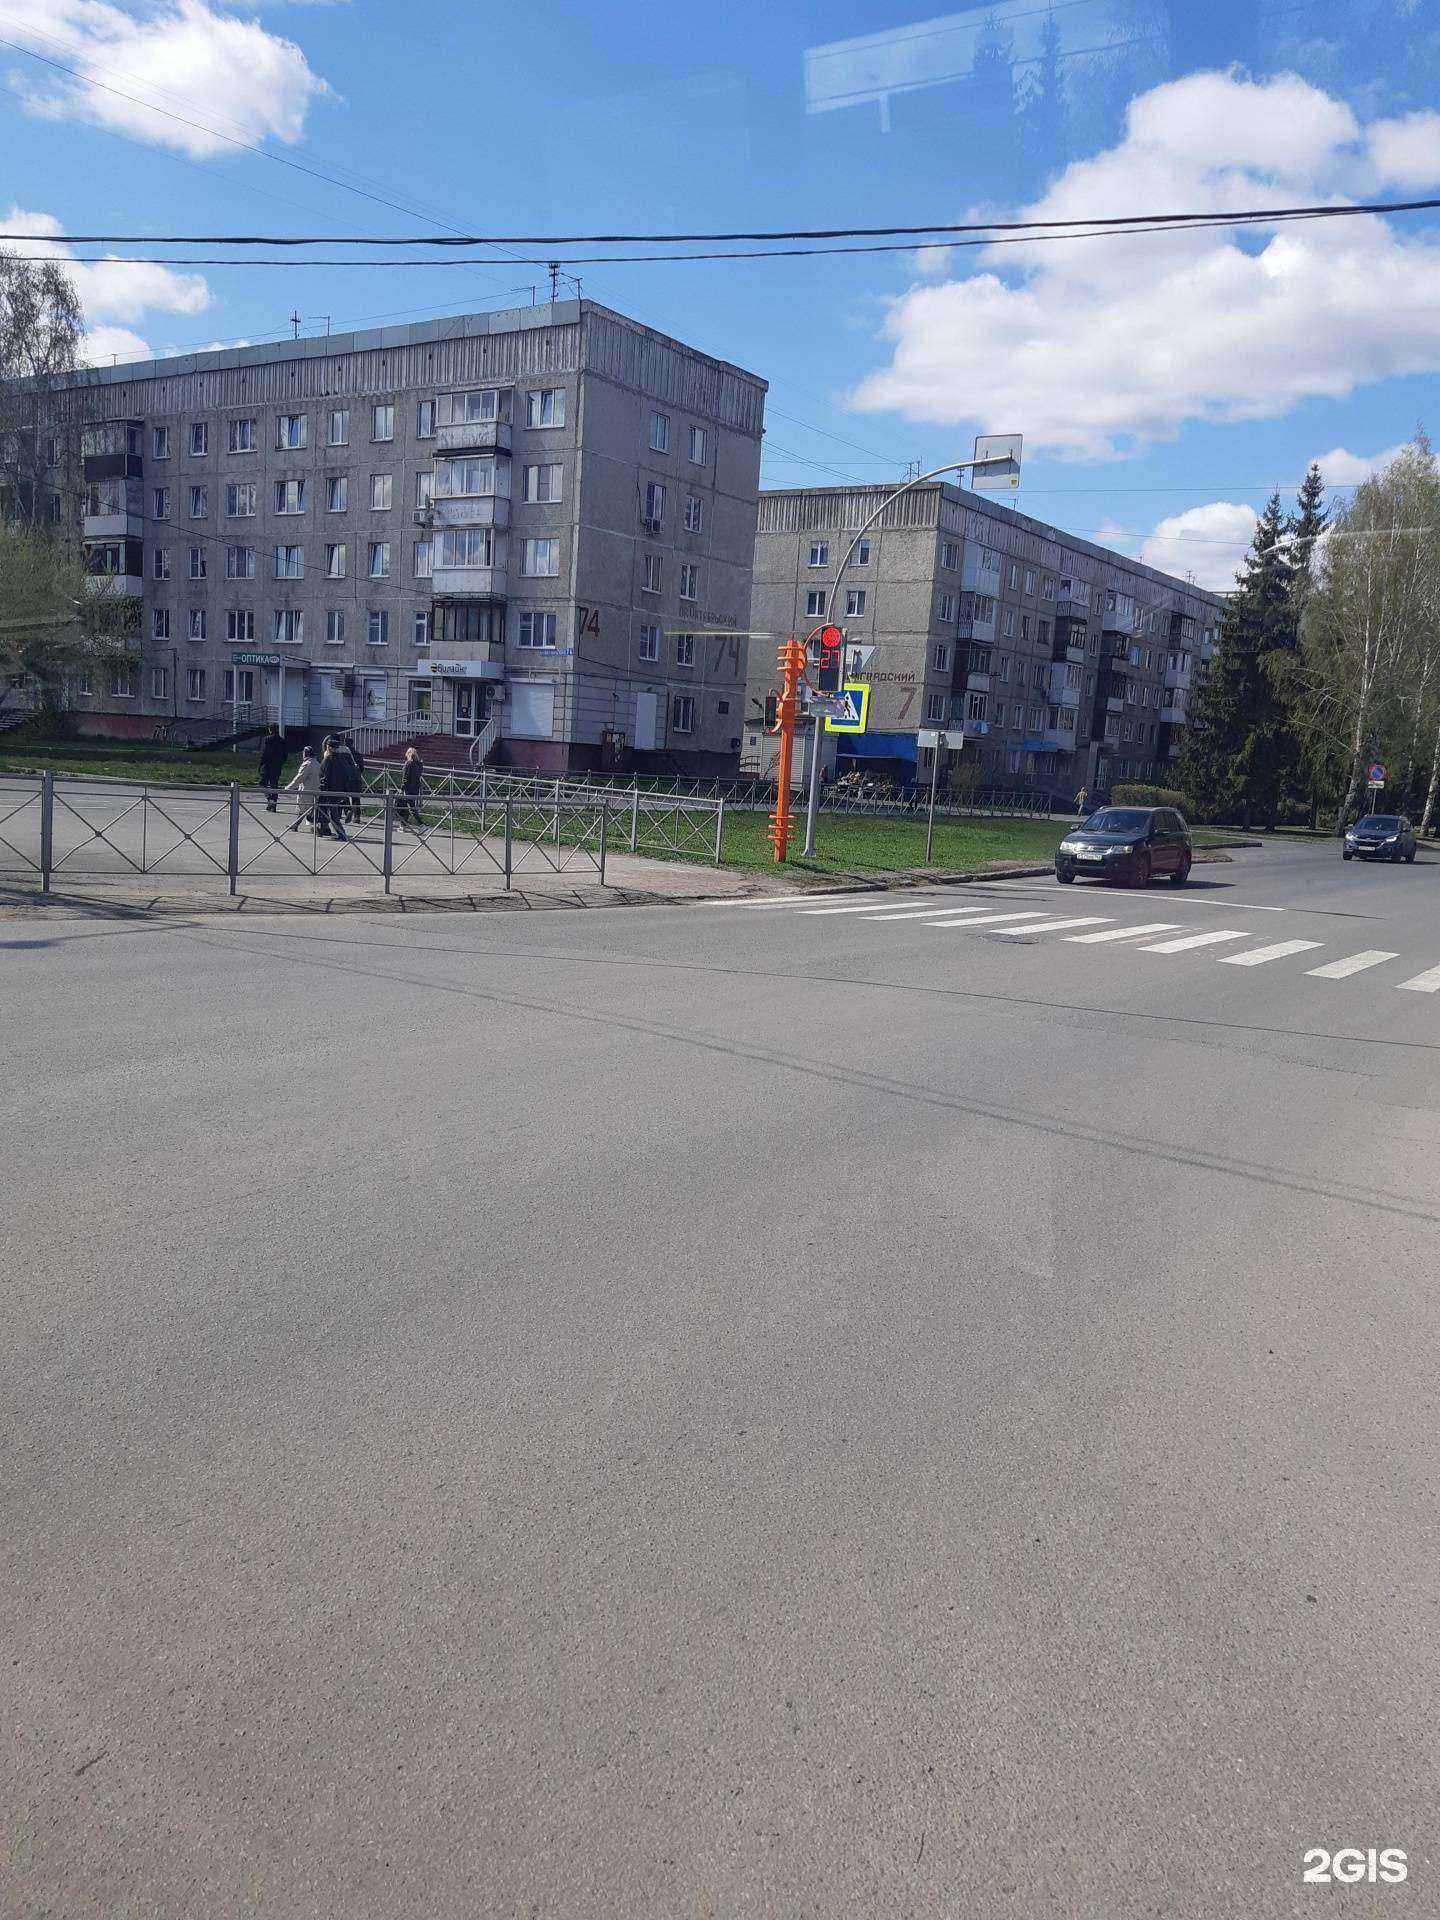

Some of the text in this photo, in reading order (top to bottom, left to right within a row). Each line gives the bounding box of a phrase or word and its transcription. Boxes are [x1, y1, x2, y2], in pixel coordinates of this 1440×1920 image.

[579, 606, 600, 638] 74
[241, 654, 270, 664] ОПТИКА
[820, 650, 840, 669] 27
[898, 687, 916, 720] 7
